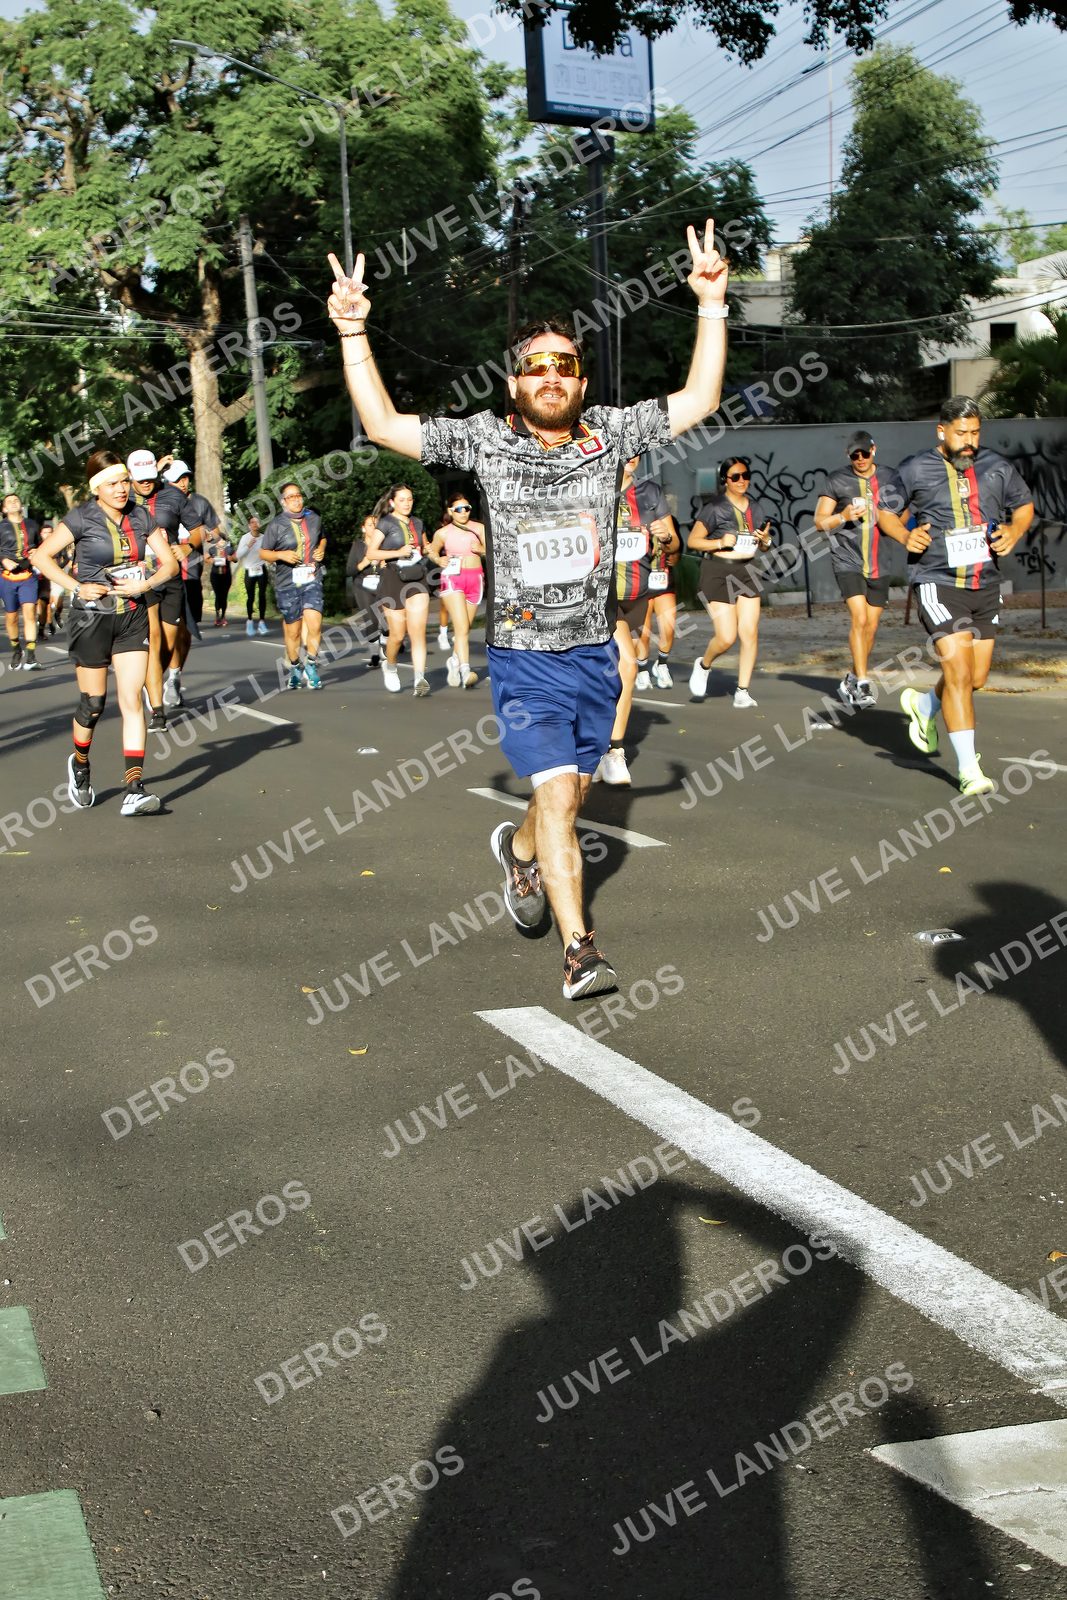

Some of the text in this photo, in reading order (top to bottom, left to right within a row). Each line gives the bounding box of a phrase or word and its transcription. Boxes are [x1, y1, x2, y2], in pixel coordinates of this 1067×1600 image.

[522, 535, 588, 562] 10330
[617, 537, 639, 548] 907
[950, 537, 986, 553] 12678
